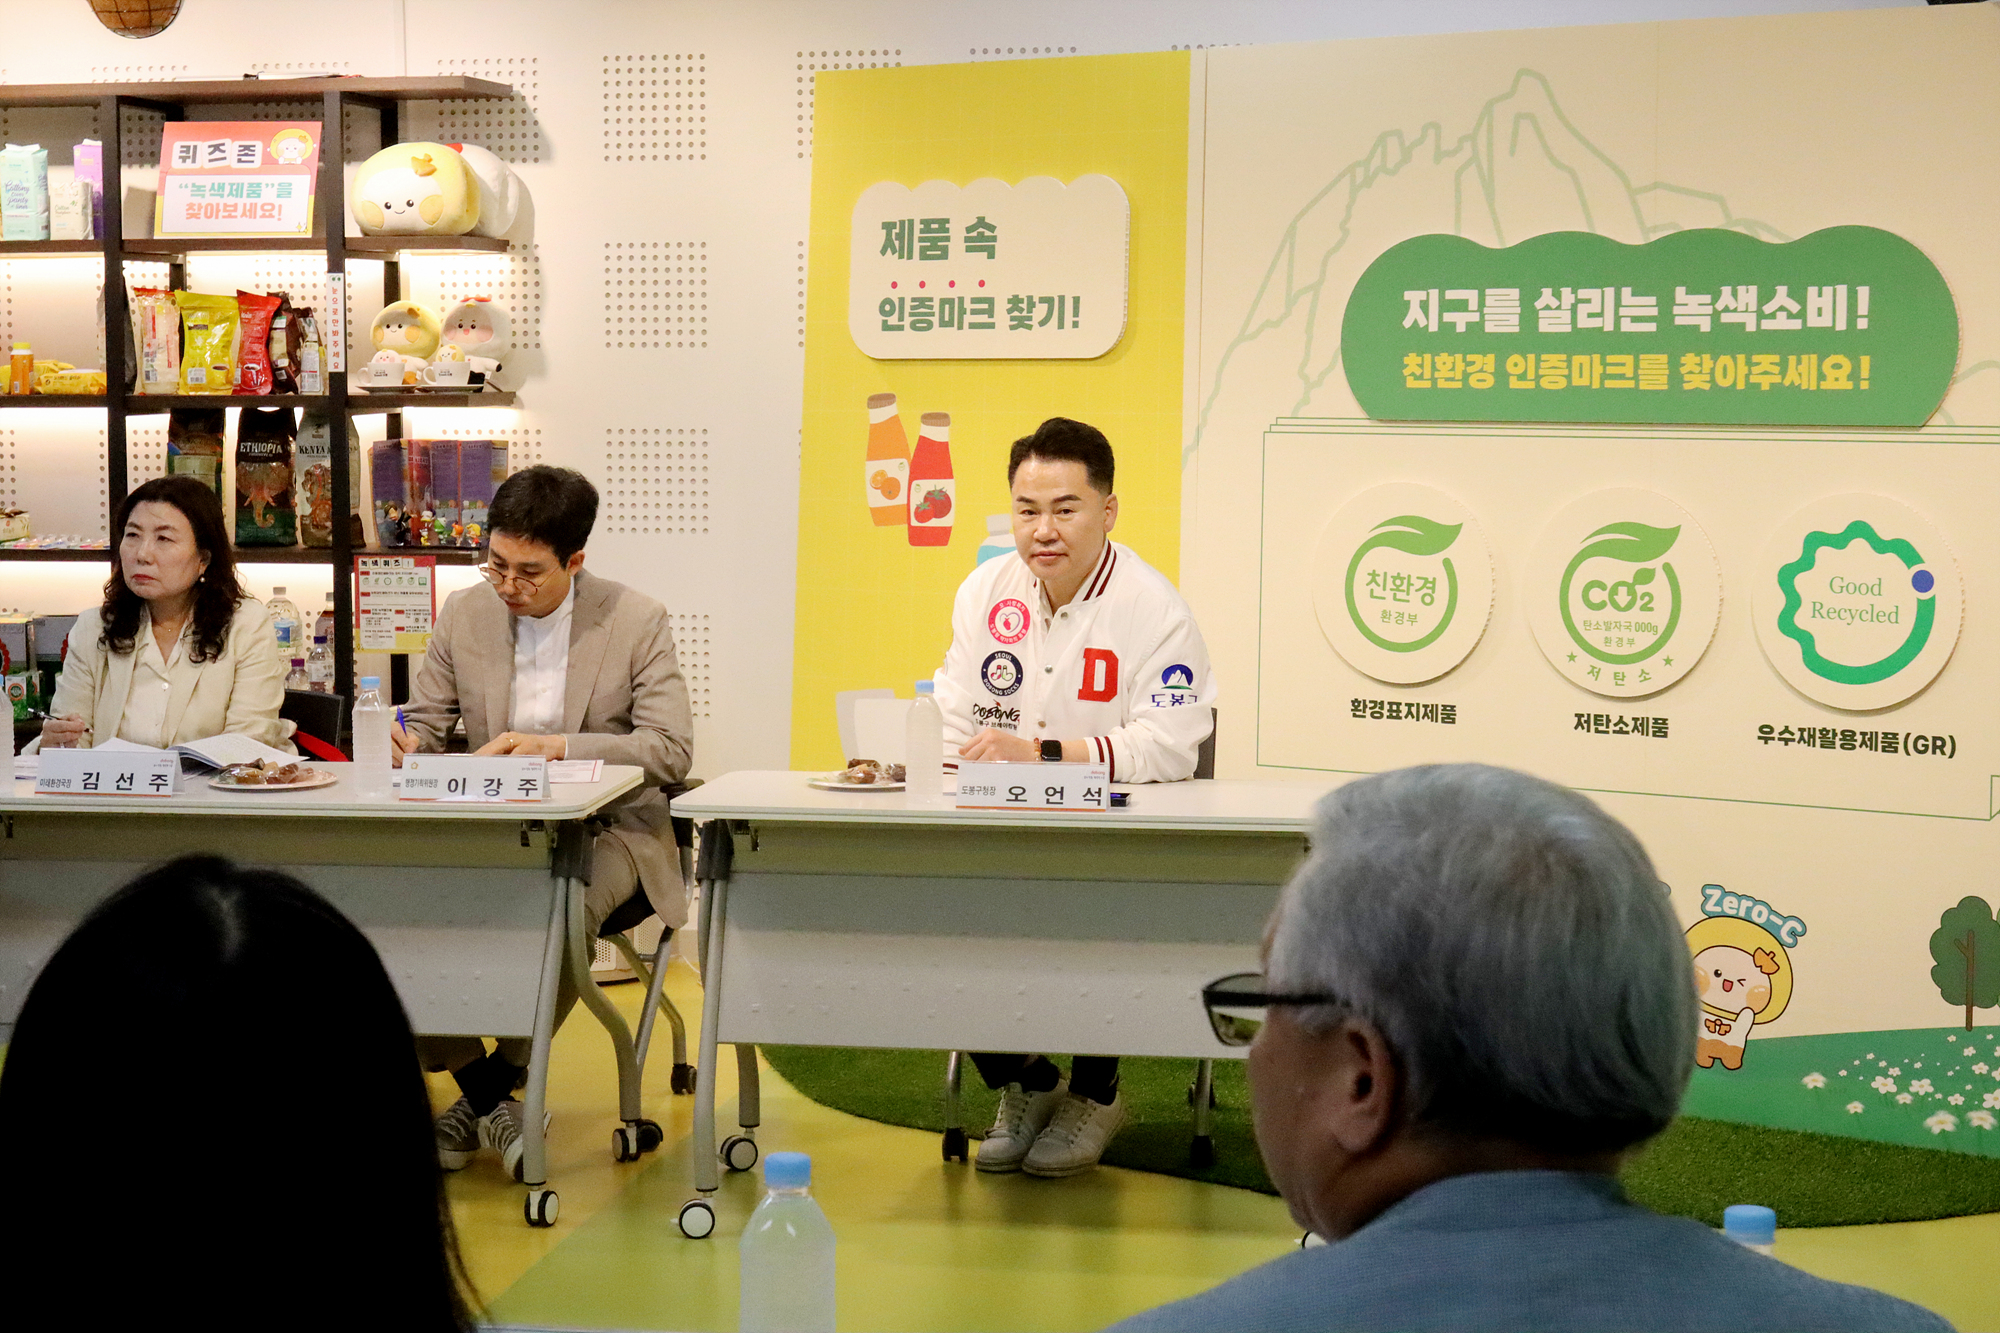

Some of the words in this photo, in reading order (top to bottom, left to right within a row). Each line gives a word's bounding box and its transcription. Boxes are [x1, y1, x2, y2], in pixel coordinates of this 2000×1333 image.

[178, 142, 256, 165] 퀴즈존
[185, 201, 283, 222] 찾아보세요!
[879, 217, 951, 261] 제품
[963, 216, 998, 260] 속
[878, 296, 996, 332] 인증마크
[1005, 294, 1082, 332] 찾기!
[1402, 288, 1521, 333] 지구를
[1533, 287, 1659, 333] 살리는
[1672, 284, 1870, 332] 녹색소비!
[1402, 352, 1495, 389] 친환경
[1505, 353, 1669, 390] 인증마크를
[1679, 352, 1871, 391] 찾아주세요!
[240, 442, 283, 454] ETHIOPIA
[298, 445, 325, 455] KENYA
[1365, 569, 1437, 606] 친환경
[1829, 576, 1883, 597] Good
[1380, 609, 1418, 626] 환경부
[1811, 601, 1900, 626] Recycled
[1583, 619, 1632, 633] 탄소발자국
[1603, 636, 1636, 648] 환경부
[995, 652, 1012, 661] SEOUL
[1077, 647, 1119, 702] D
[983, 678, 1003, 696] DOBONG
[1003, 682, 1020, 696] SOCKS
[1350, 698, 1457, 725] 환경표지제품
[1573, 713, 1669, 738] 저탄소제품
[1757, 724, 1957, 759] 우수재활용제품(GR)
[961, 785, 997, 796] 도봉구청장
[1705, 888, 1803, 943] Zero-C
